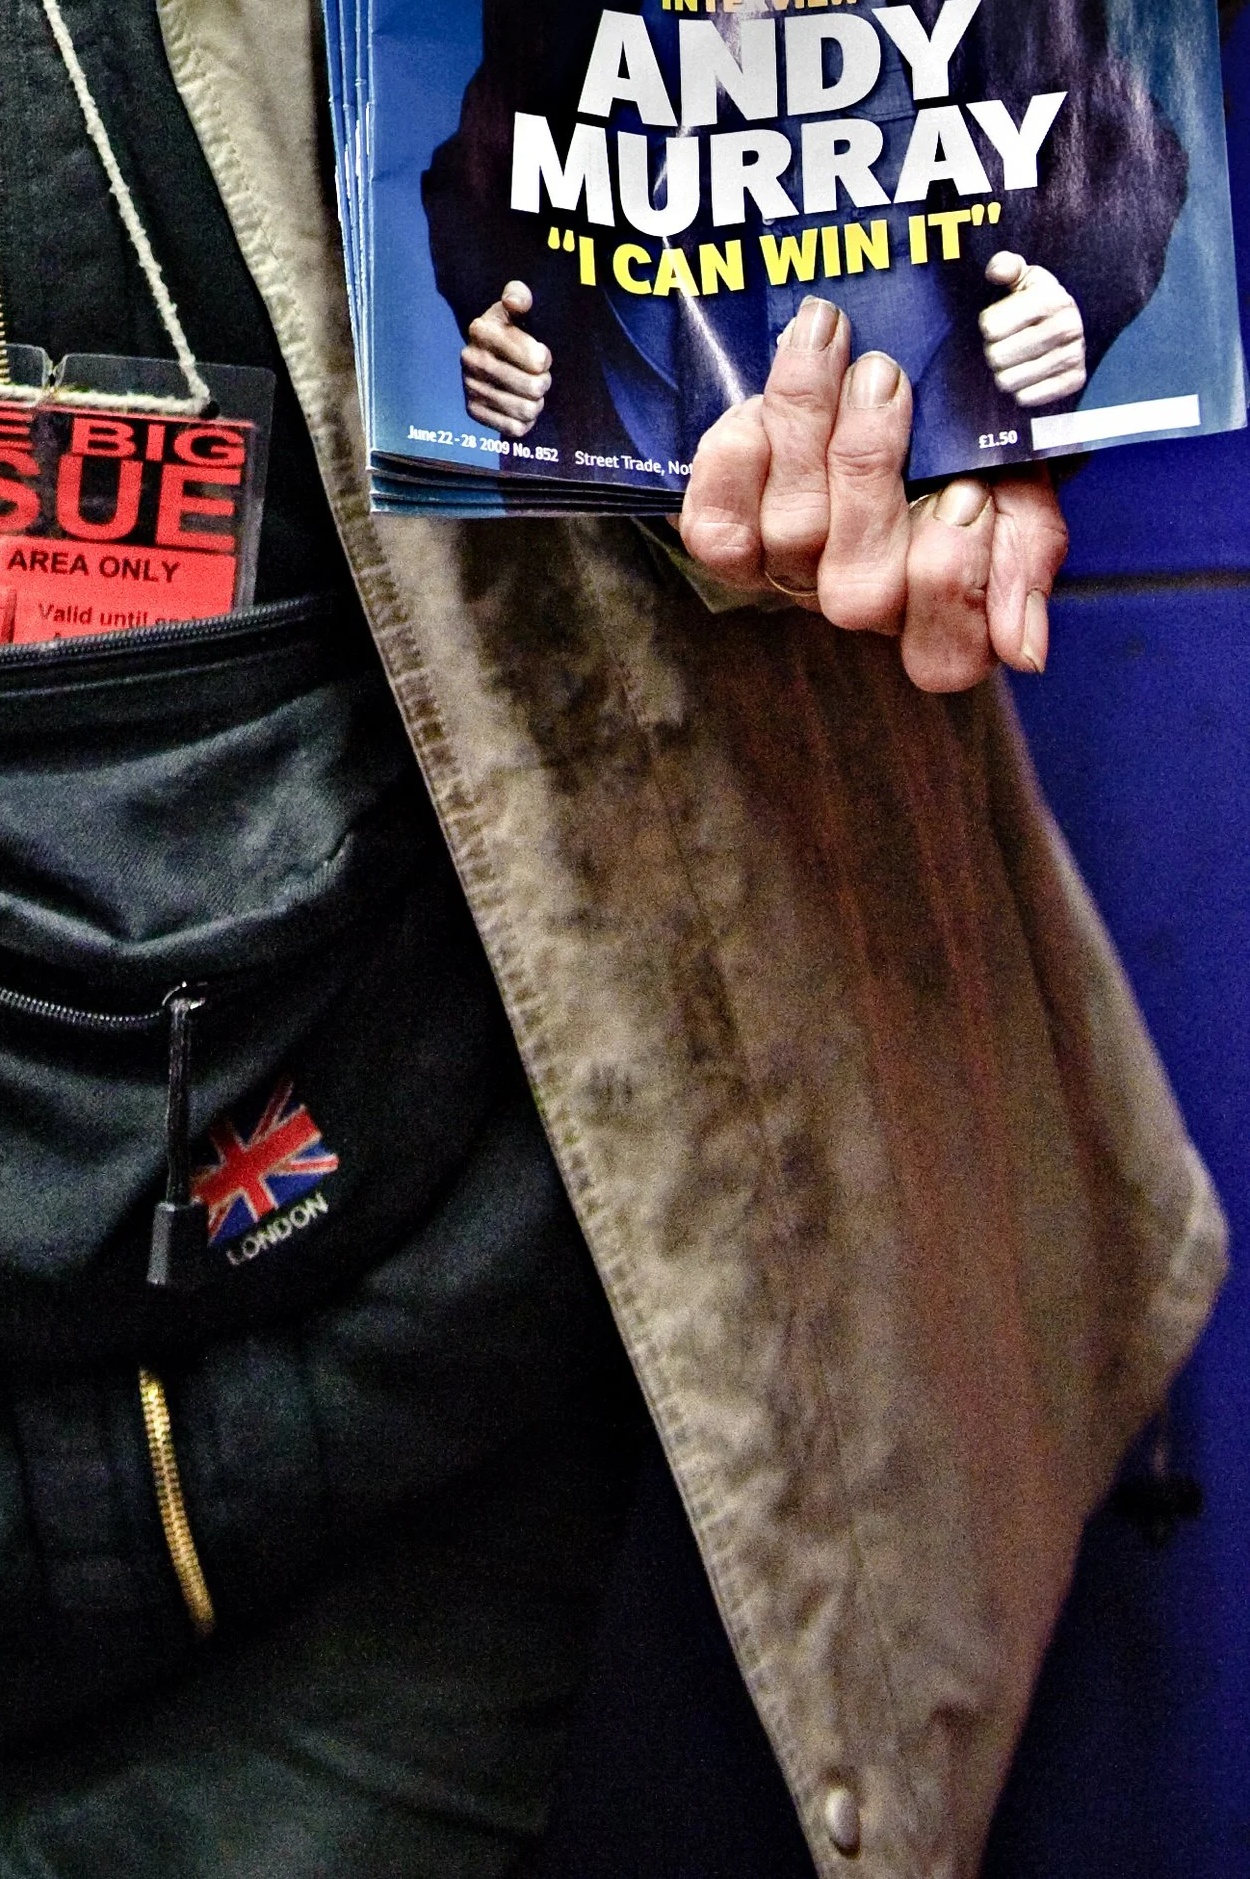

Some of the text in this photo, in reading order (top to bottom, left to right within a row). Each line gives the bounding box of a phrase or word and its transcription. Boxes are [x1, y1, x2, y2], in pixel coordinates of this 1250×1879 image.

[510, 91, 1068, 238] MURRAY
[612, 240, 746, 297] CAN
[760, 219, 890, 287] WIN
[71, 418, 247, 468] BIG
[407, 425, 436, 442] June
[461, 434, 477, 448] 28
[480, 437, 510, 455] 2009
[978, 430, 1018, 449] £1.50
[575, 451, 619, 469] Street
[621, 455, 665, 476] Trade,
[7, 548, 89, 576] AREA
[99, 555, 181, 583] ONLY
[38, 602, 93, 625] Valid
[225, 1191, 330, 1266] LONDON
